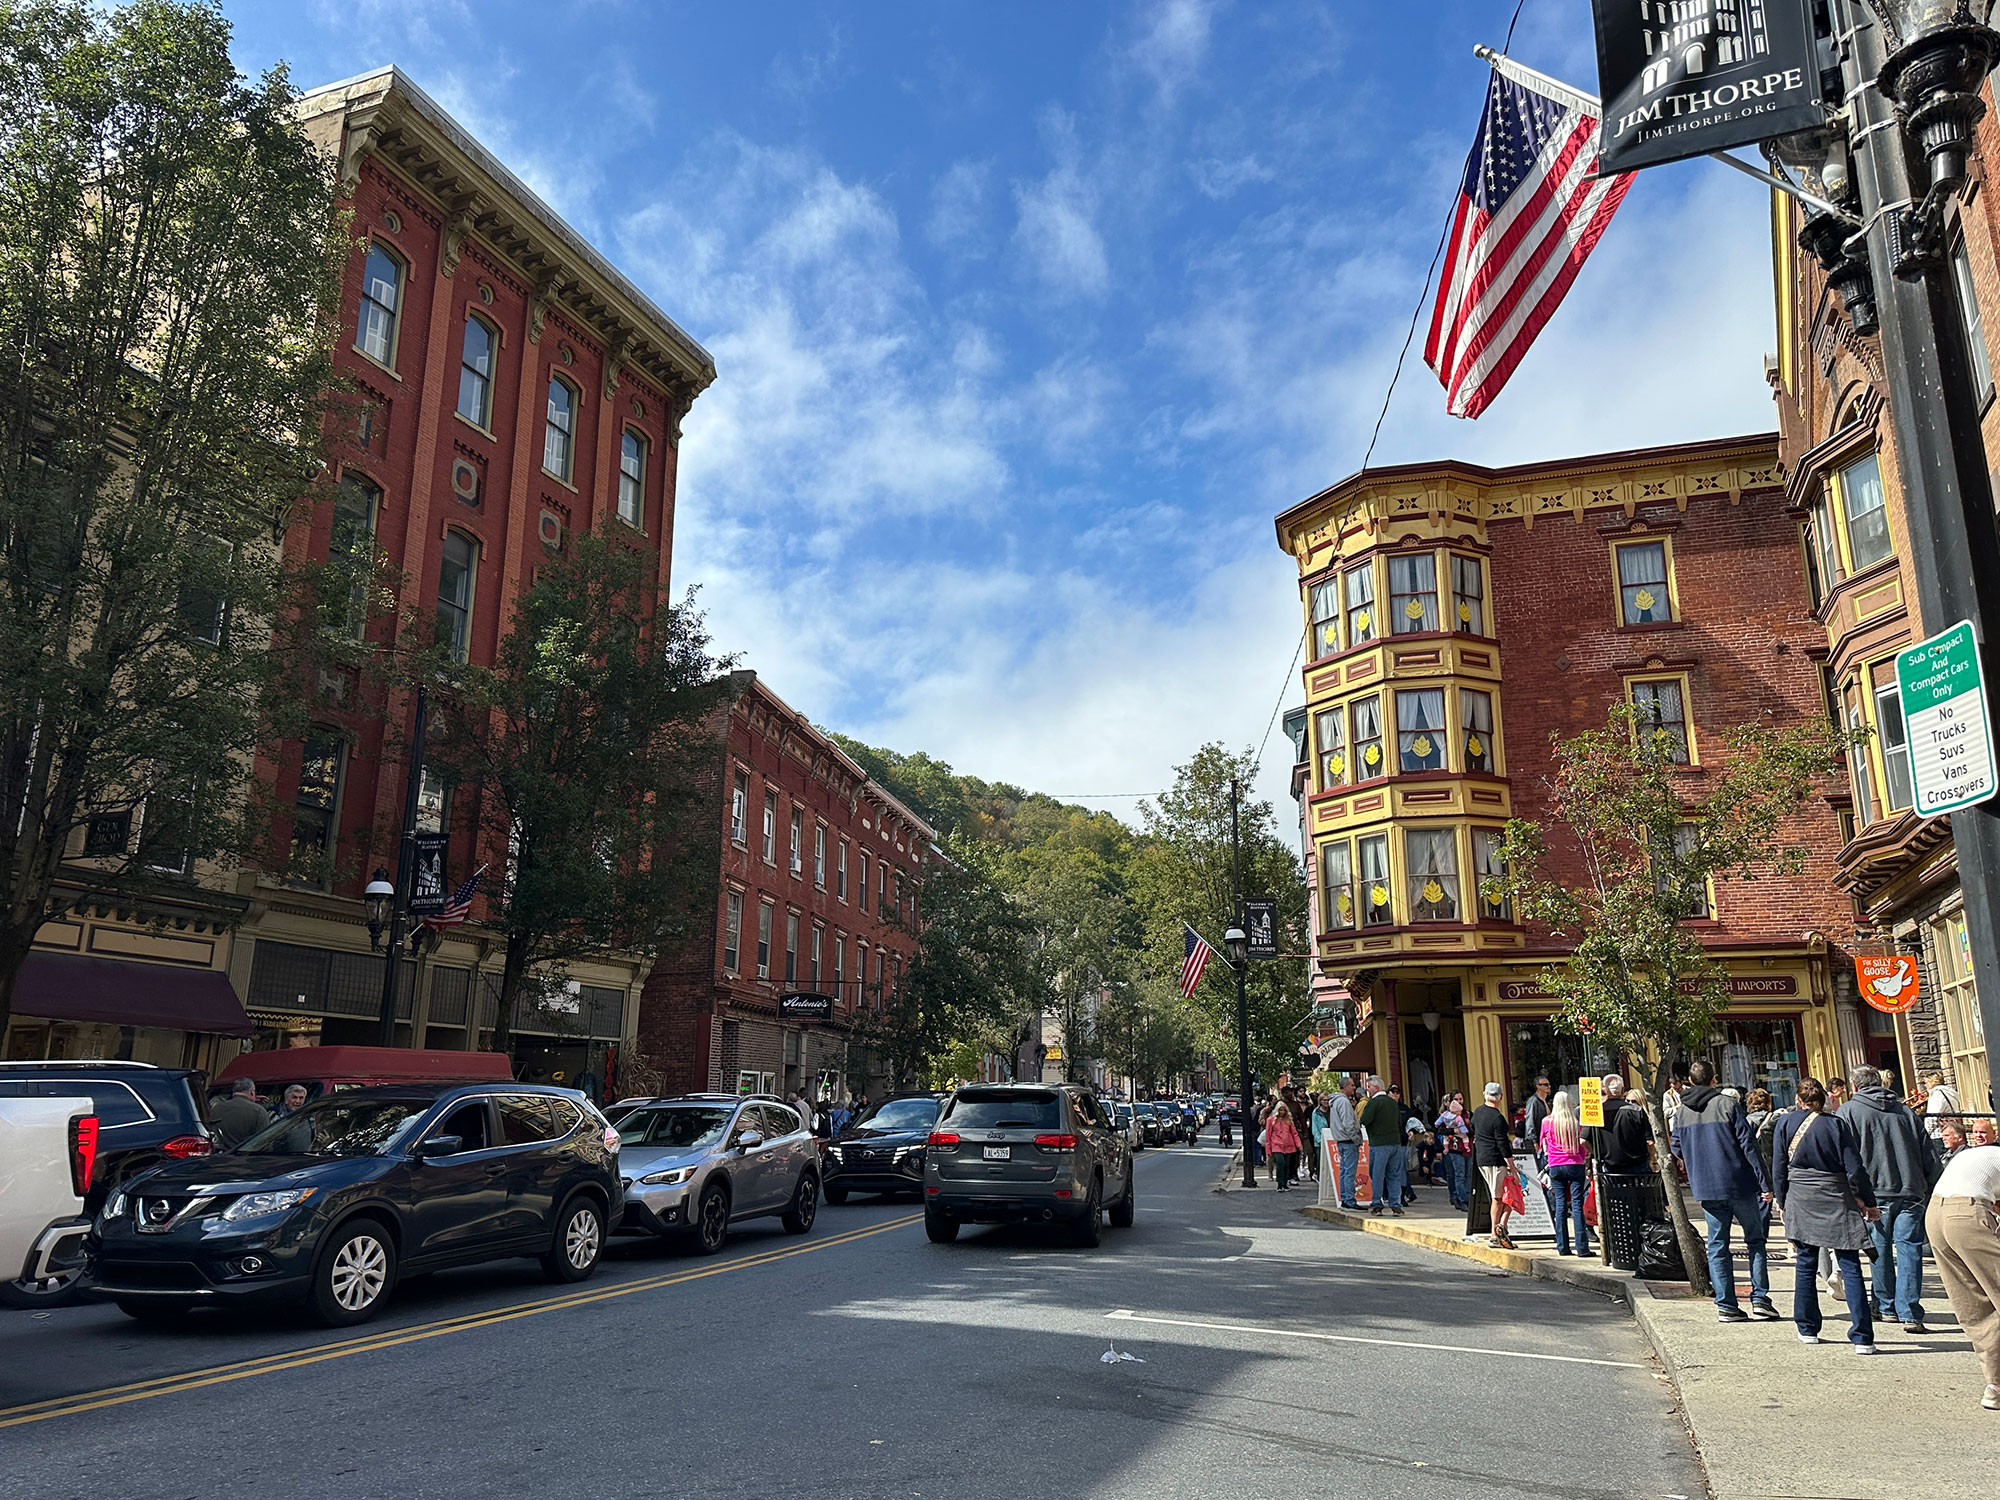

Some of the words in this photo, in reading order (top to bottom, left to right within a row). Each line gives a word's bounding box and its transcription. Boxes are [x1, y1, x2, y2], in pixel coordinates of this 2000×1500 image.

[1613, 98, 1664, 138] JIM
[1665, 67, 1803, 117] THORPE
[1637, 101, 1777, 143] JIMTHORPE.ORG
[1908, 652, 1926, 666] Sub
[1931, 655, 1948, 671] And
[1910, 668, 1949, 692] Compact
[1950, 660, 1969, 675] Cars
[1932, 683, 1953, 698] Only
[1939, 707, 1953, 721] No
[1931, 722, 1967, 743] Trucks
[1939, 743, 1965, 760] Suvs
[1942, 764, 1968, 780] Vans
[1927, 777, 1985, 804] Crossovers
[1872, 958, 1891, 968] SILLY
[1863, 966, 1891, 976] GOOSE
[1737, 980, 1787, 991] IMPORTS
[783, 996, 829, 1008] Antonio's
[1581, 1088, 1599, 1096] PARKING
[987, 1131, 1006, 1140] Jeep
